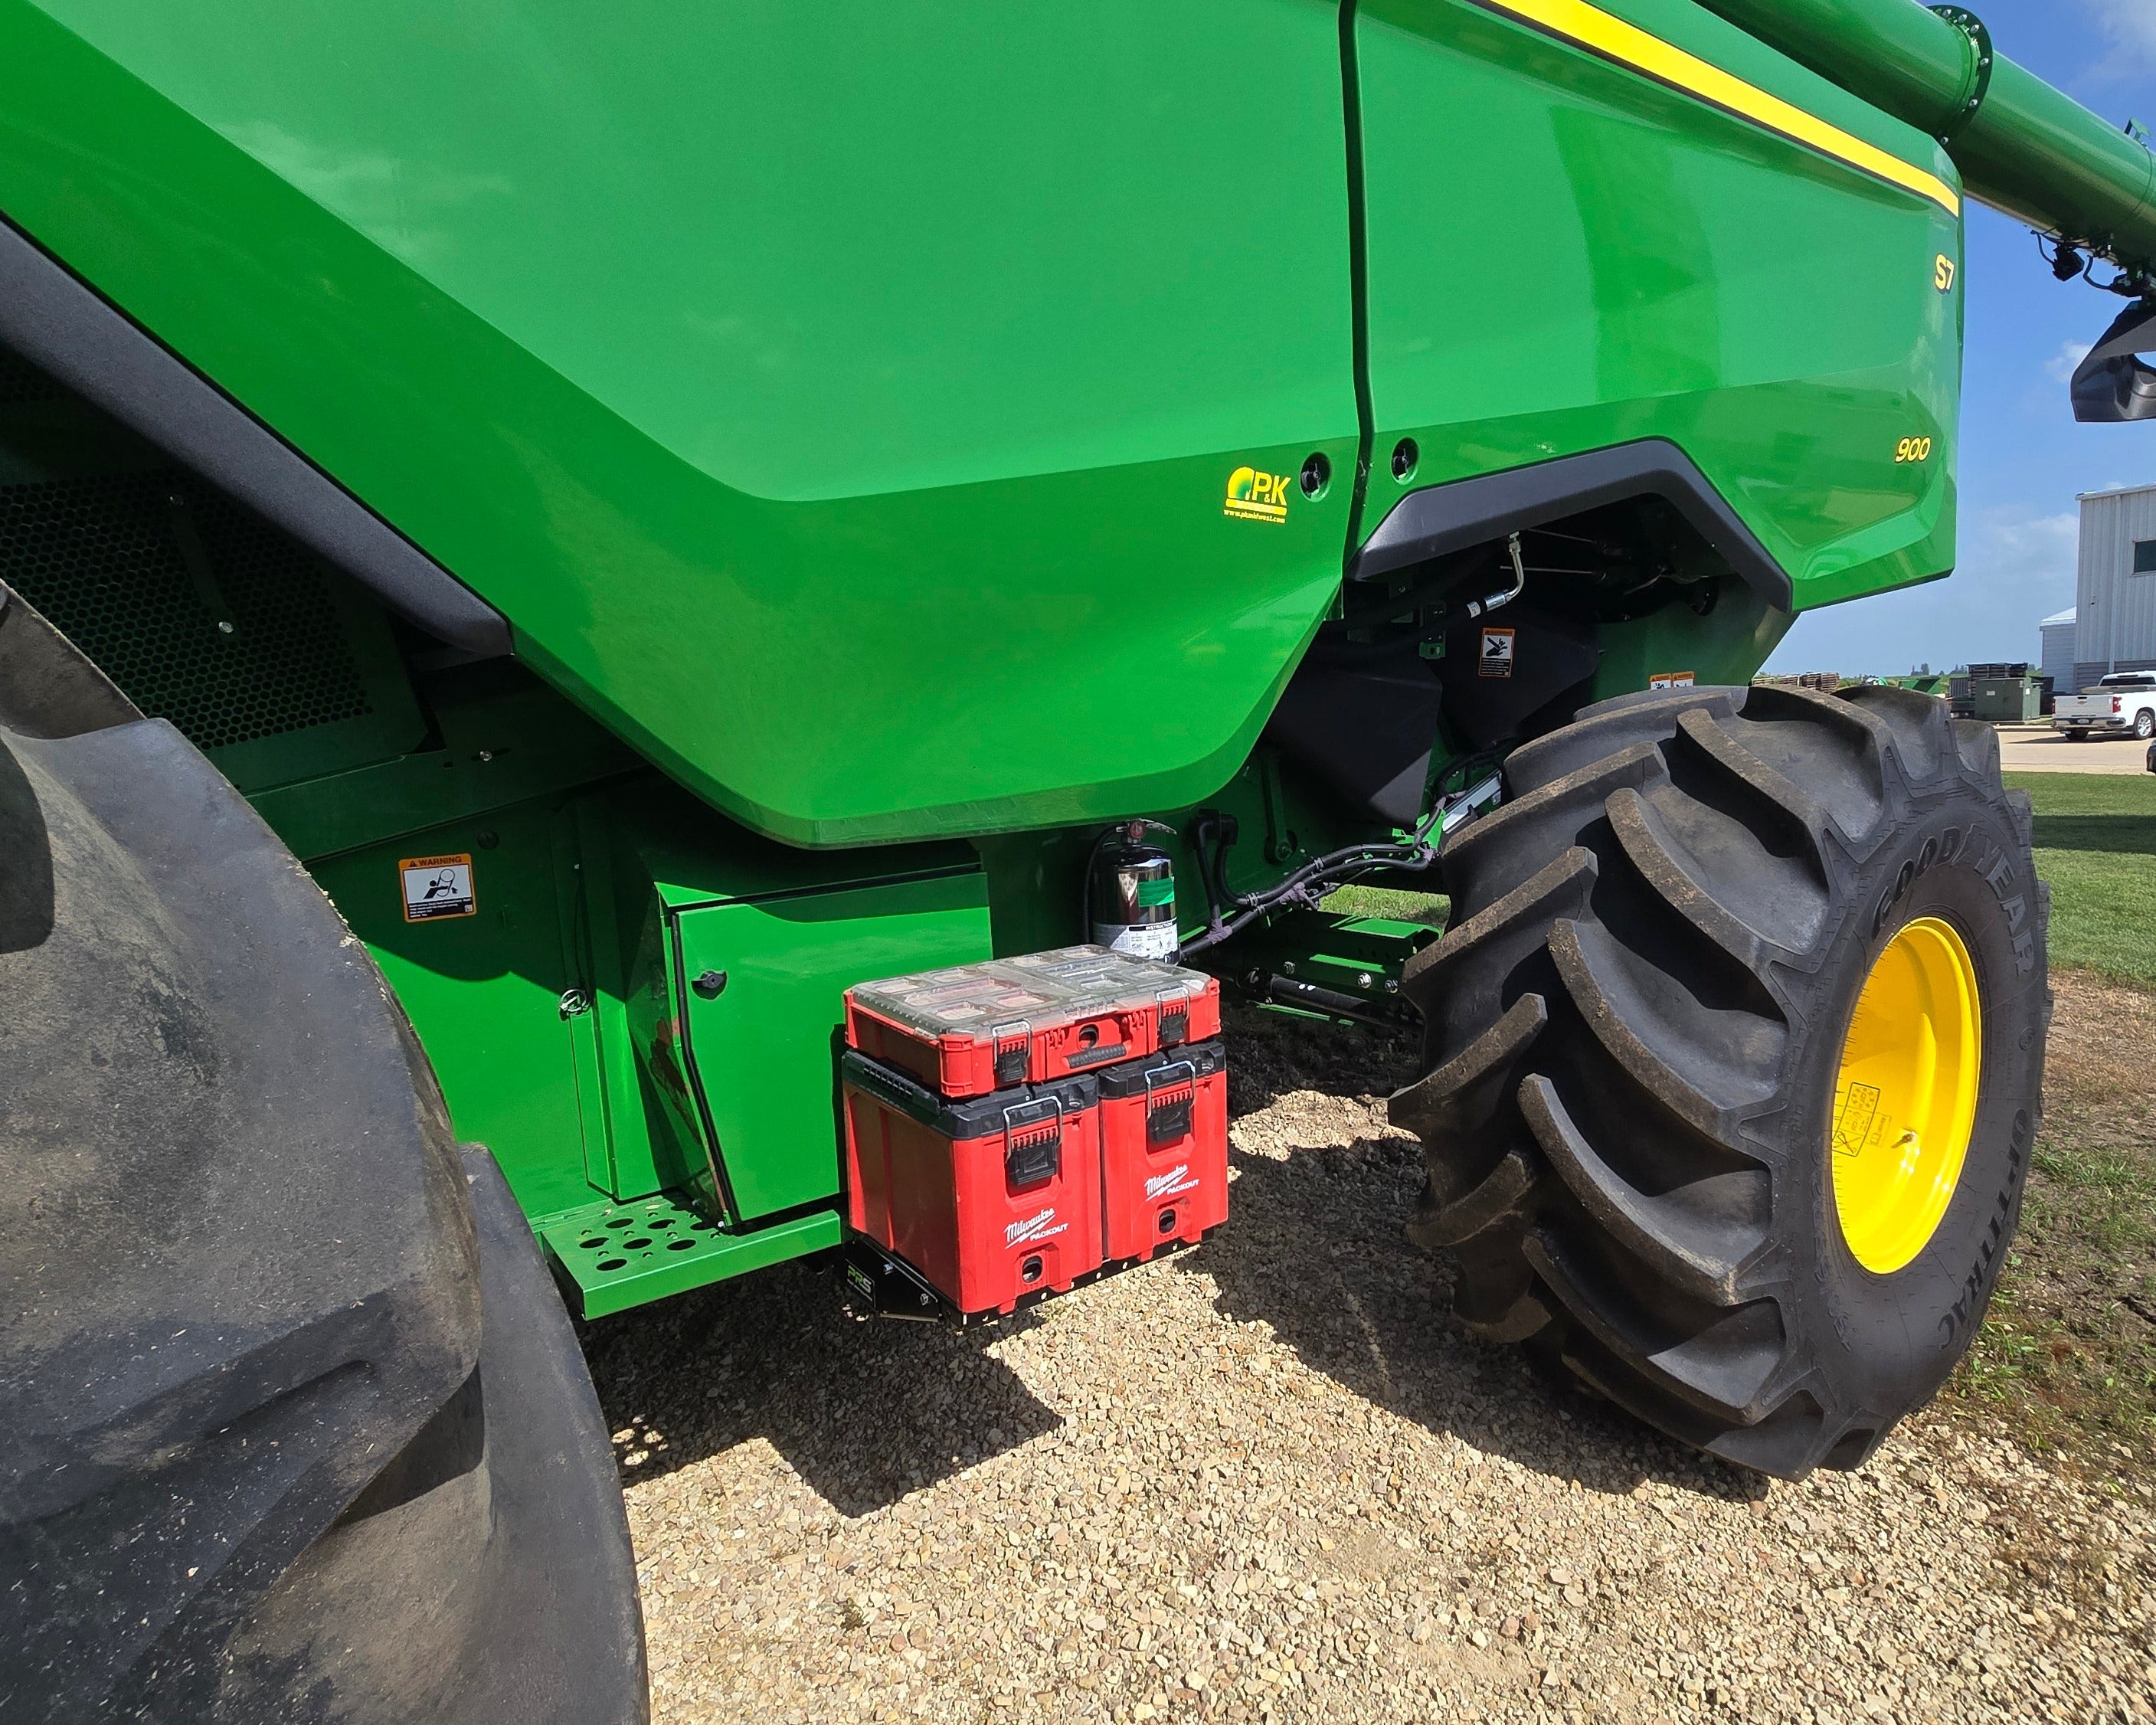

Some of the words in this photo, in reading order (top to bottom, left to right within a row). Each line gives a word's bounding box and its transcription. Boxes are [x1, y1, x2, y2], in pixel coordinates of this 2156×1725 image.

[1935, 254, 1955, 290] S7
[1895, 437, 1931, 462] 900
[1251, 471, 1291, 506] P&K
[419, 856, 463, 866] WARNING
[1144, 1164, 1189, 1196] Milwaukee
[1166, 1179, 1200, 1196] PACKOUT
[1003, 1207, 1055, 1242] Milwaukee
[1029, 1223, 1069, 1242] PACKOUT
[847, 1265, 872, 1294] PRS
